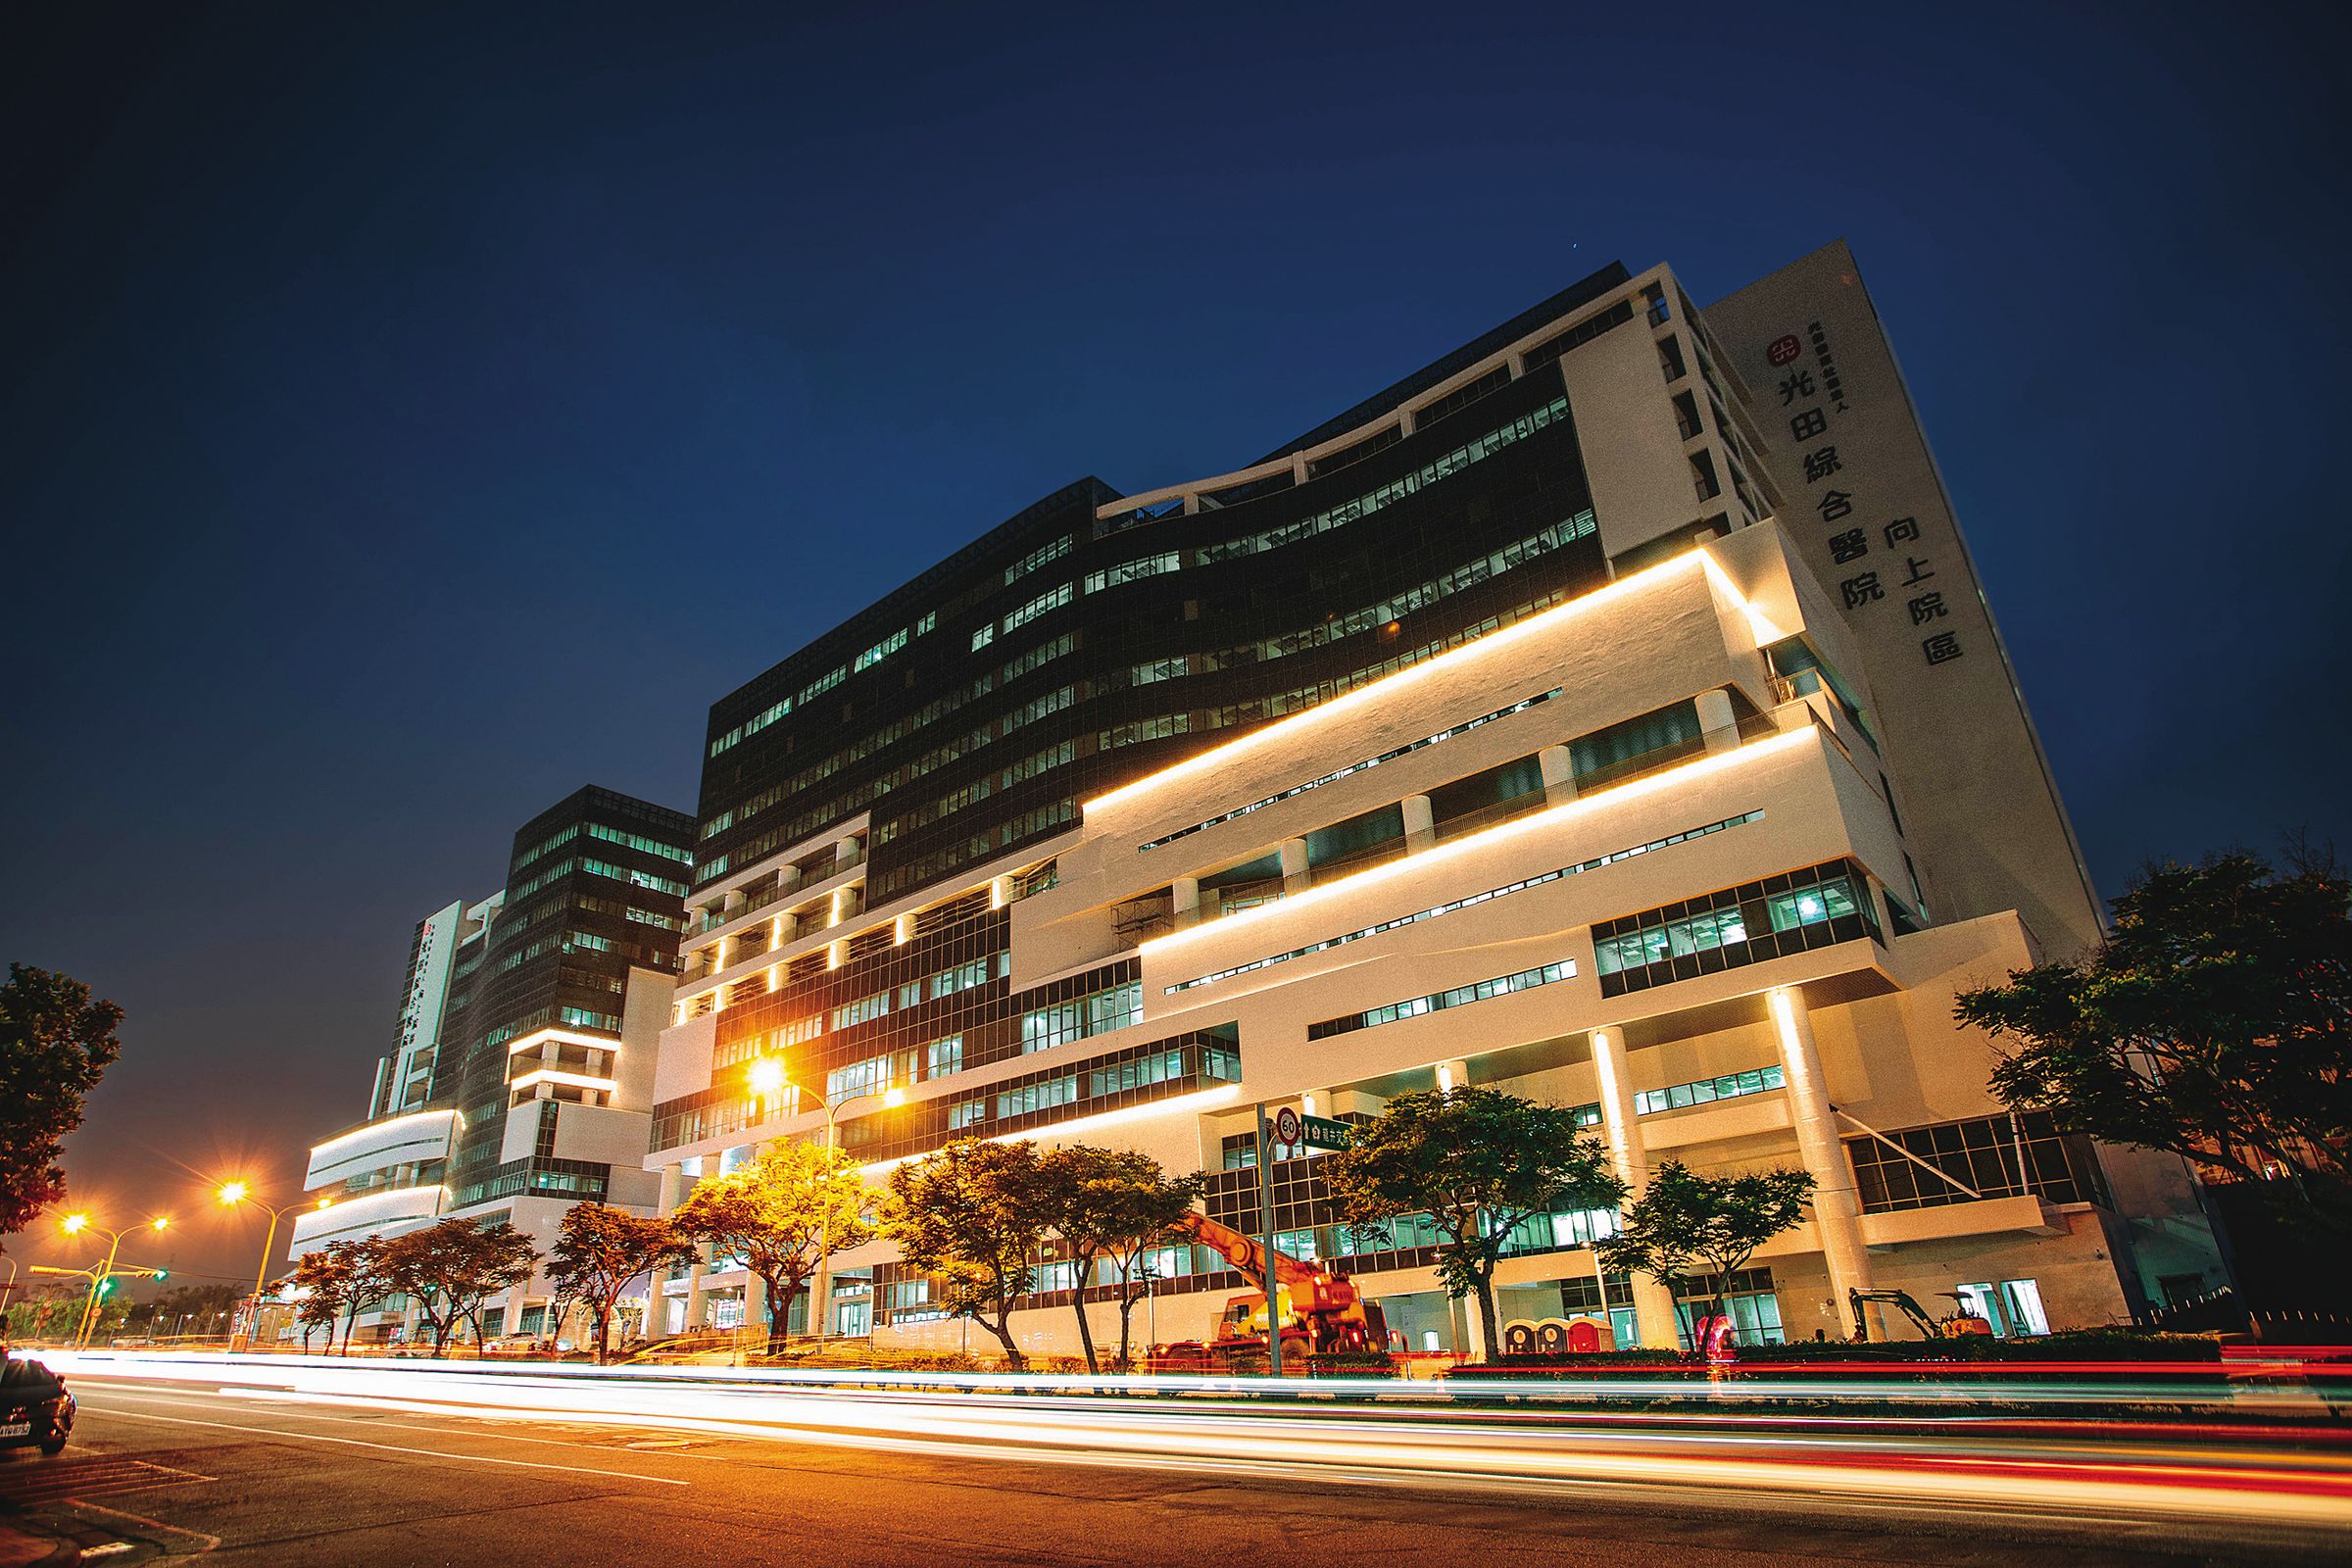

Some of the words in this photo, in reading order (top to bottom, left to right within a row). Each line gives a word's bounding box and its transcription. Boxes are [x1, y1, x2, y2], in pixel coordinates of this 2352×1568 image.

[1779, 370, 1886, 611] 光田綜合醫院
[1883, 516, 1964, 666] 向上院區
[1282, 1119, 1295, 1134] 60
